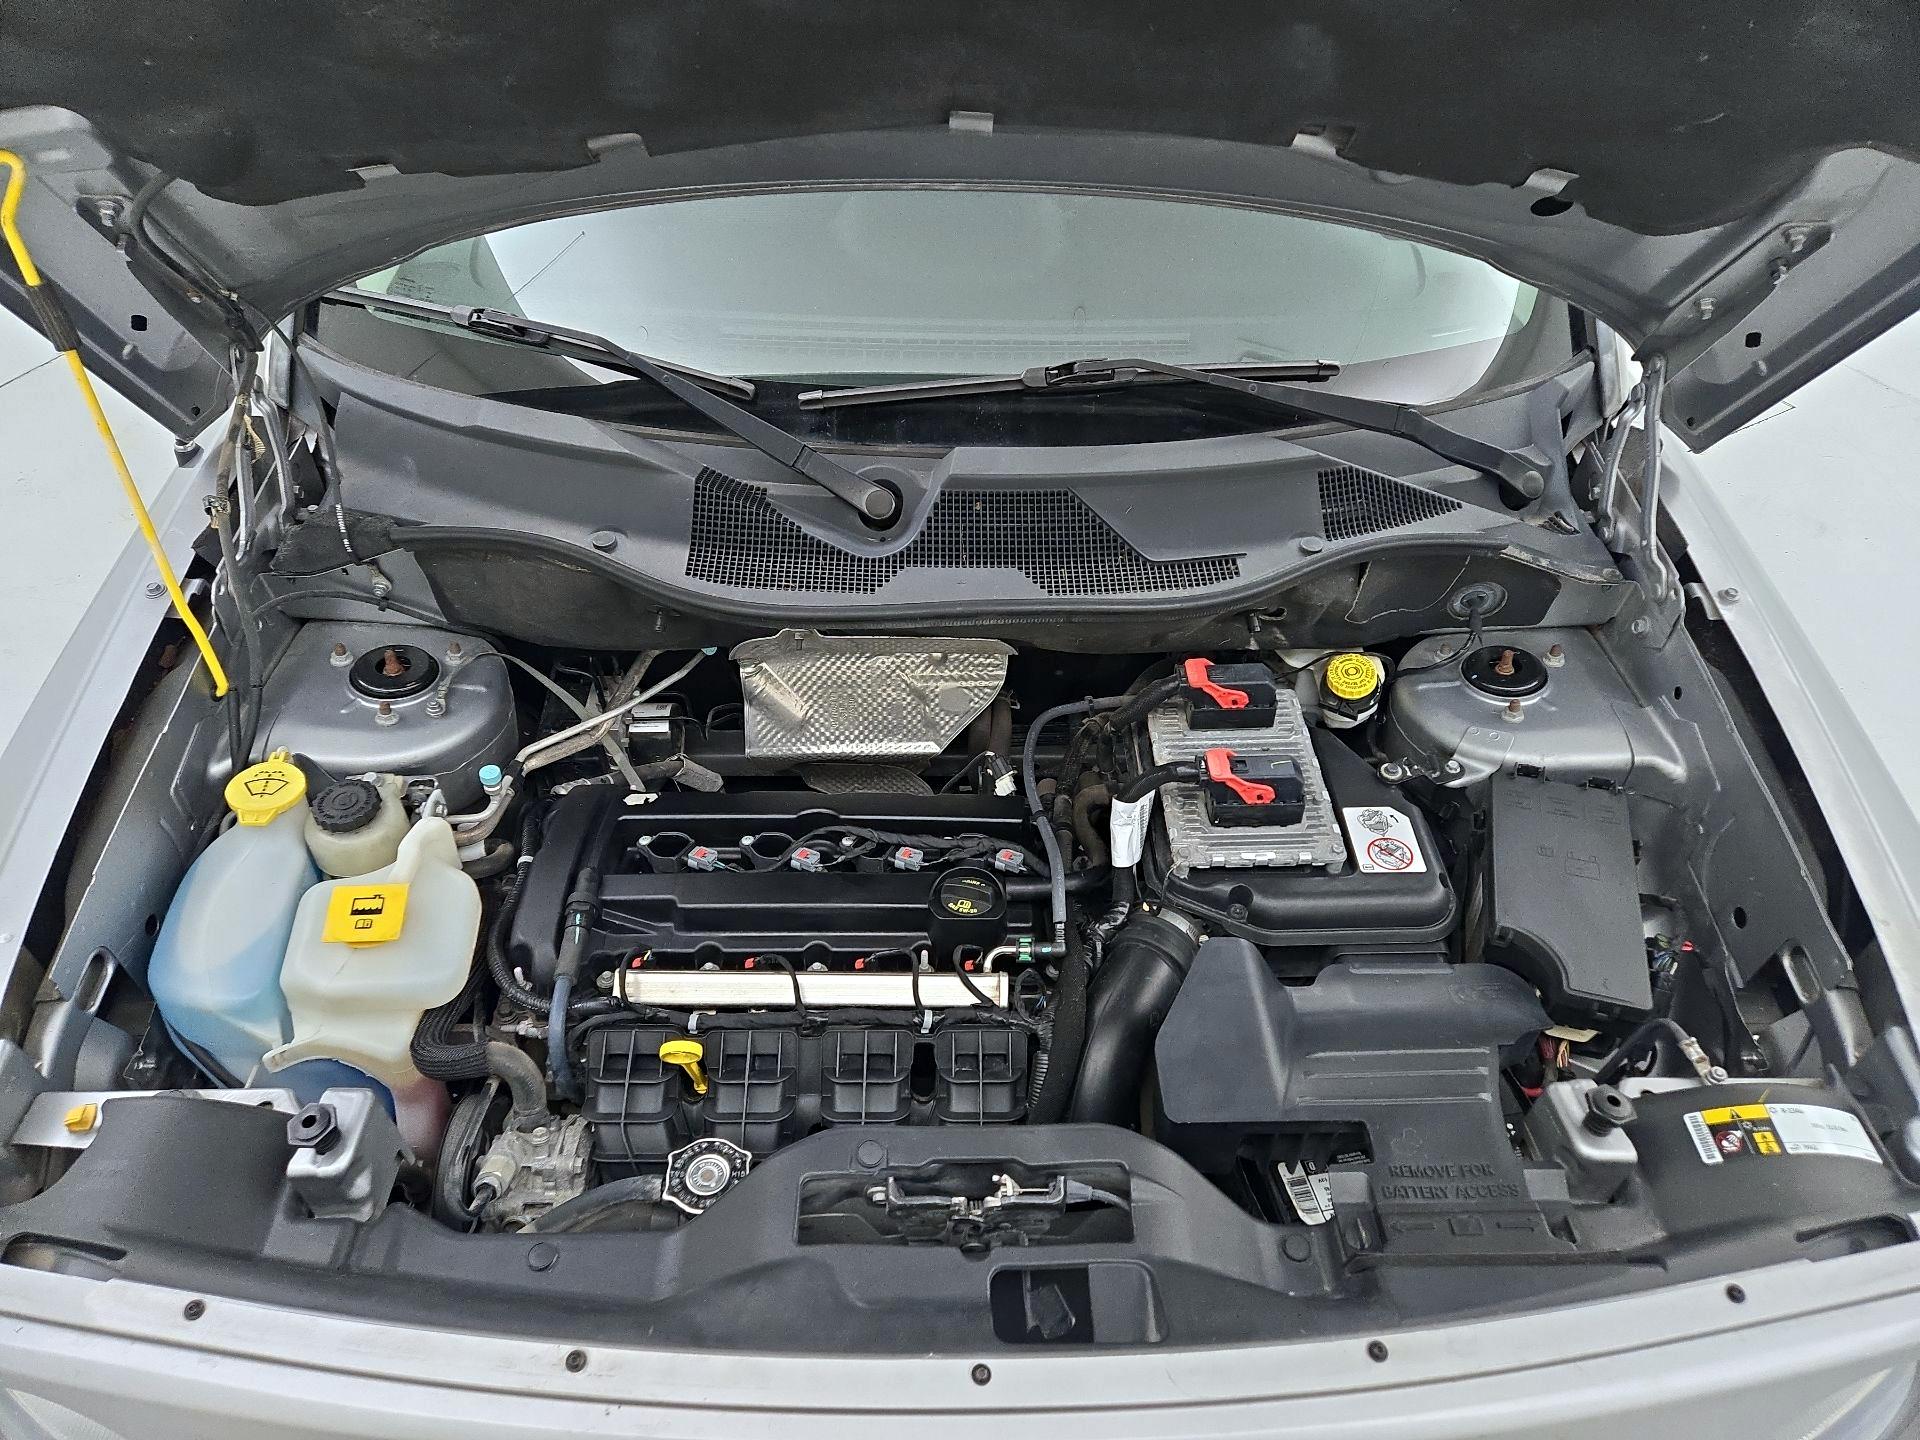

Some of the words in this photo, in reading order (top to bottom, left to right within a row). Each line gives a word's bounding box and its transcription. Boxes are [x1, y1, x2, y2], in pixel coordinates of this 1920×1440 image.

[1389, 1164, 1456, 1178] REMOVE
[1459, 1163, 1496, 1177] FOR
[1381, 1184, 1450, 1199] BATTERY
[1454, 1183, 1520, 1199] ACCESS
